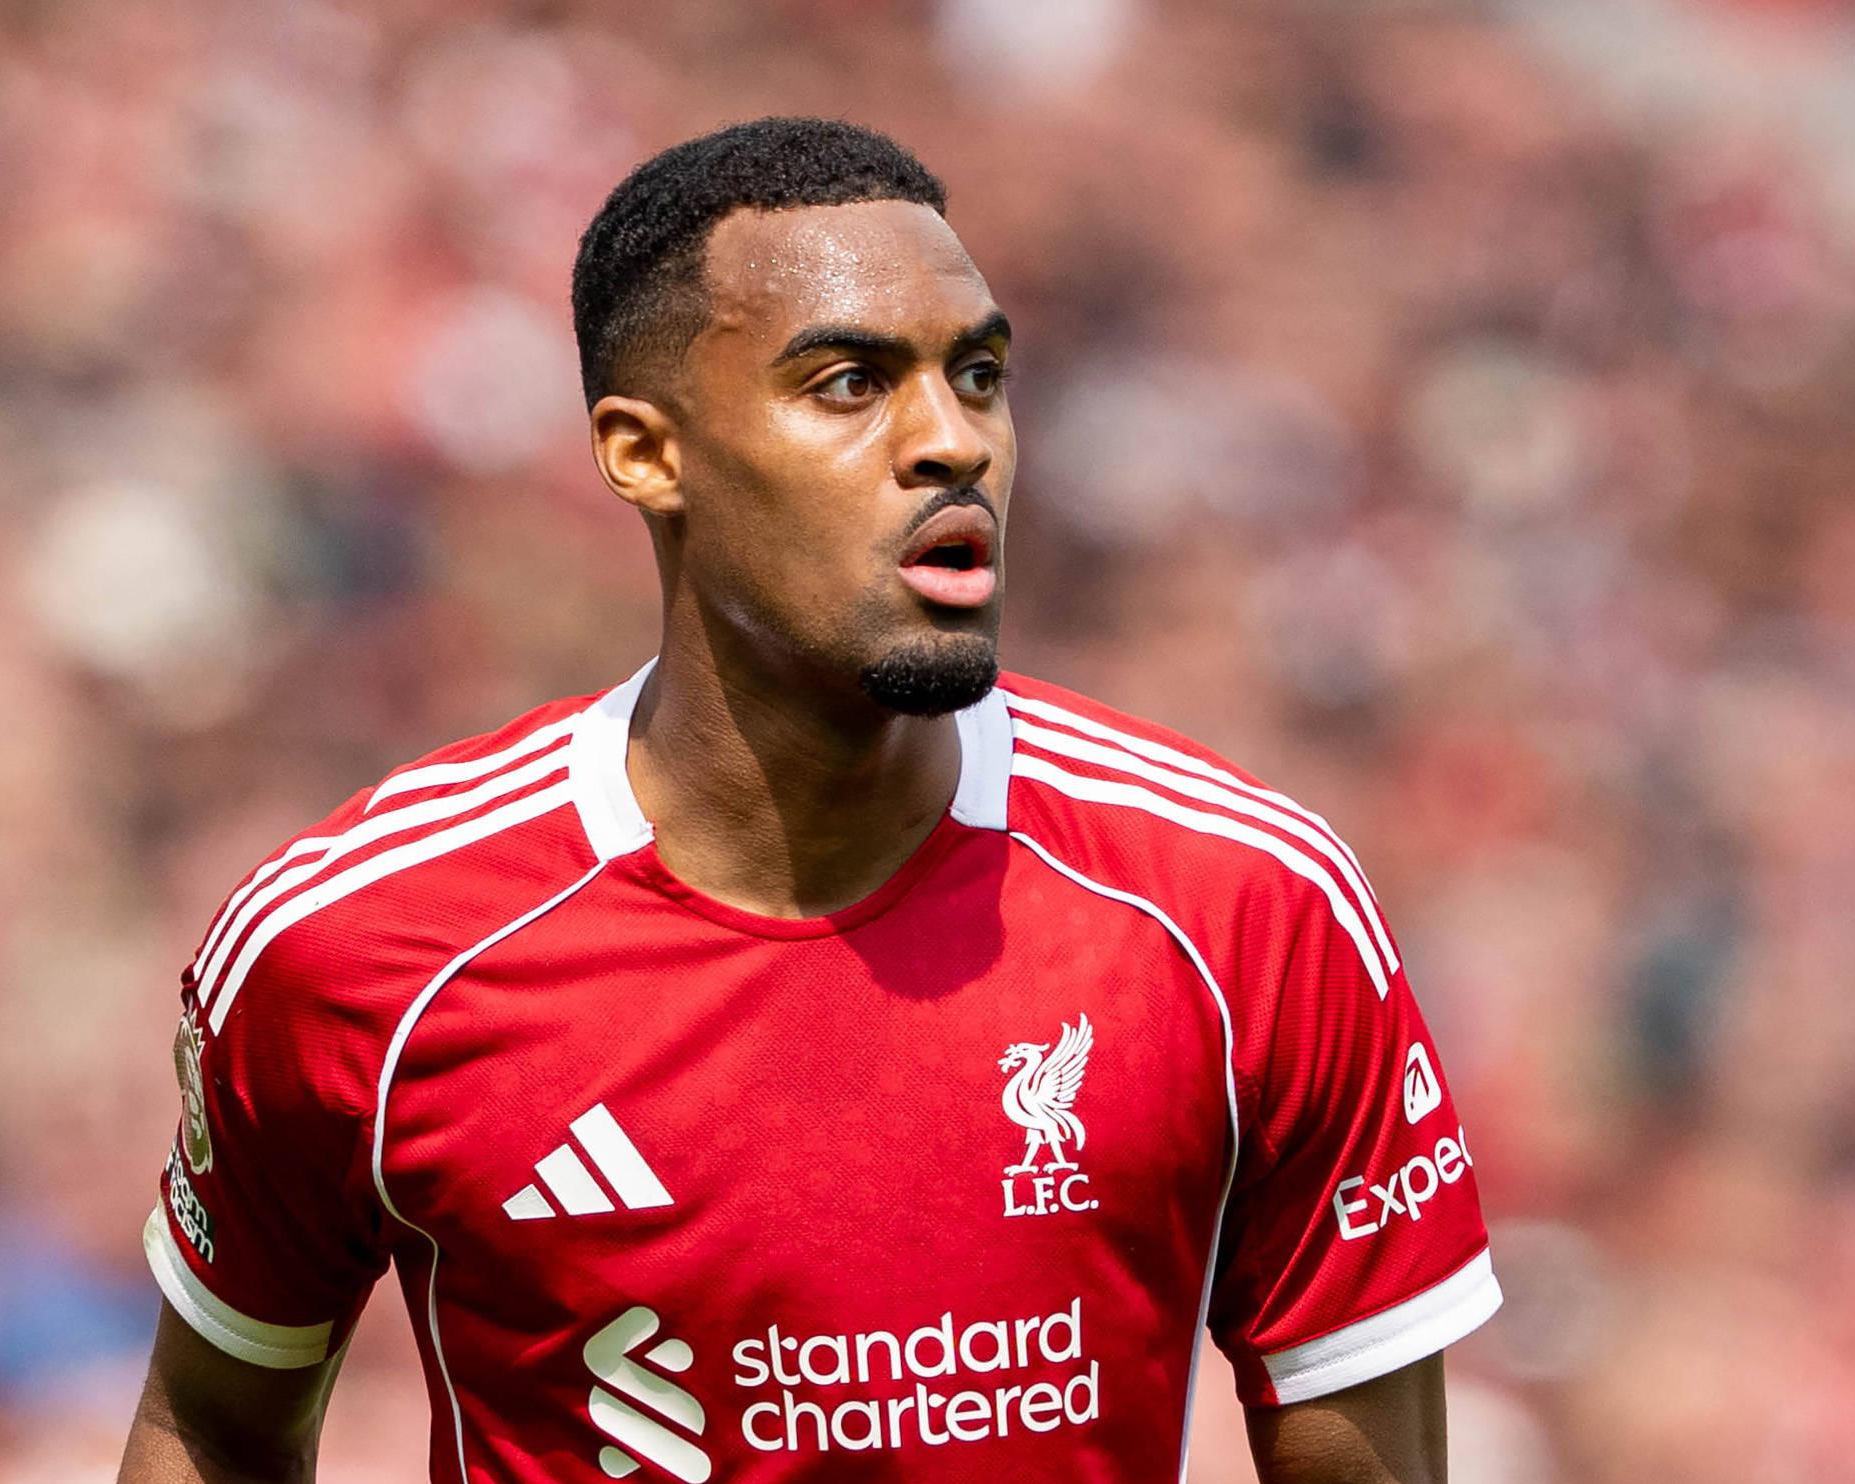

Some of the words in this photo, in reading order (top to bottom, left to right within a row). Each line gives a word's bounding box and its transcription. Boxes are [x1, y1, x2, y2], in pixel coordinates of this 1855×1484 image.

[1001, 1173, 1099, 1217] L.F.C.
[732, 1296, 1082, 1387] standard
[741, 1360, 1100, 1452] chartered
